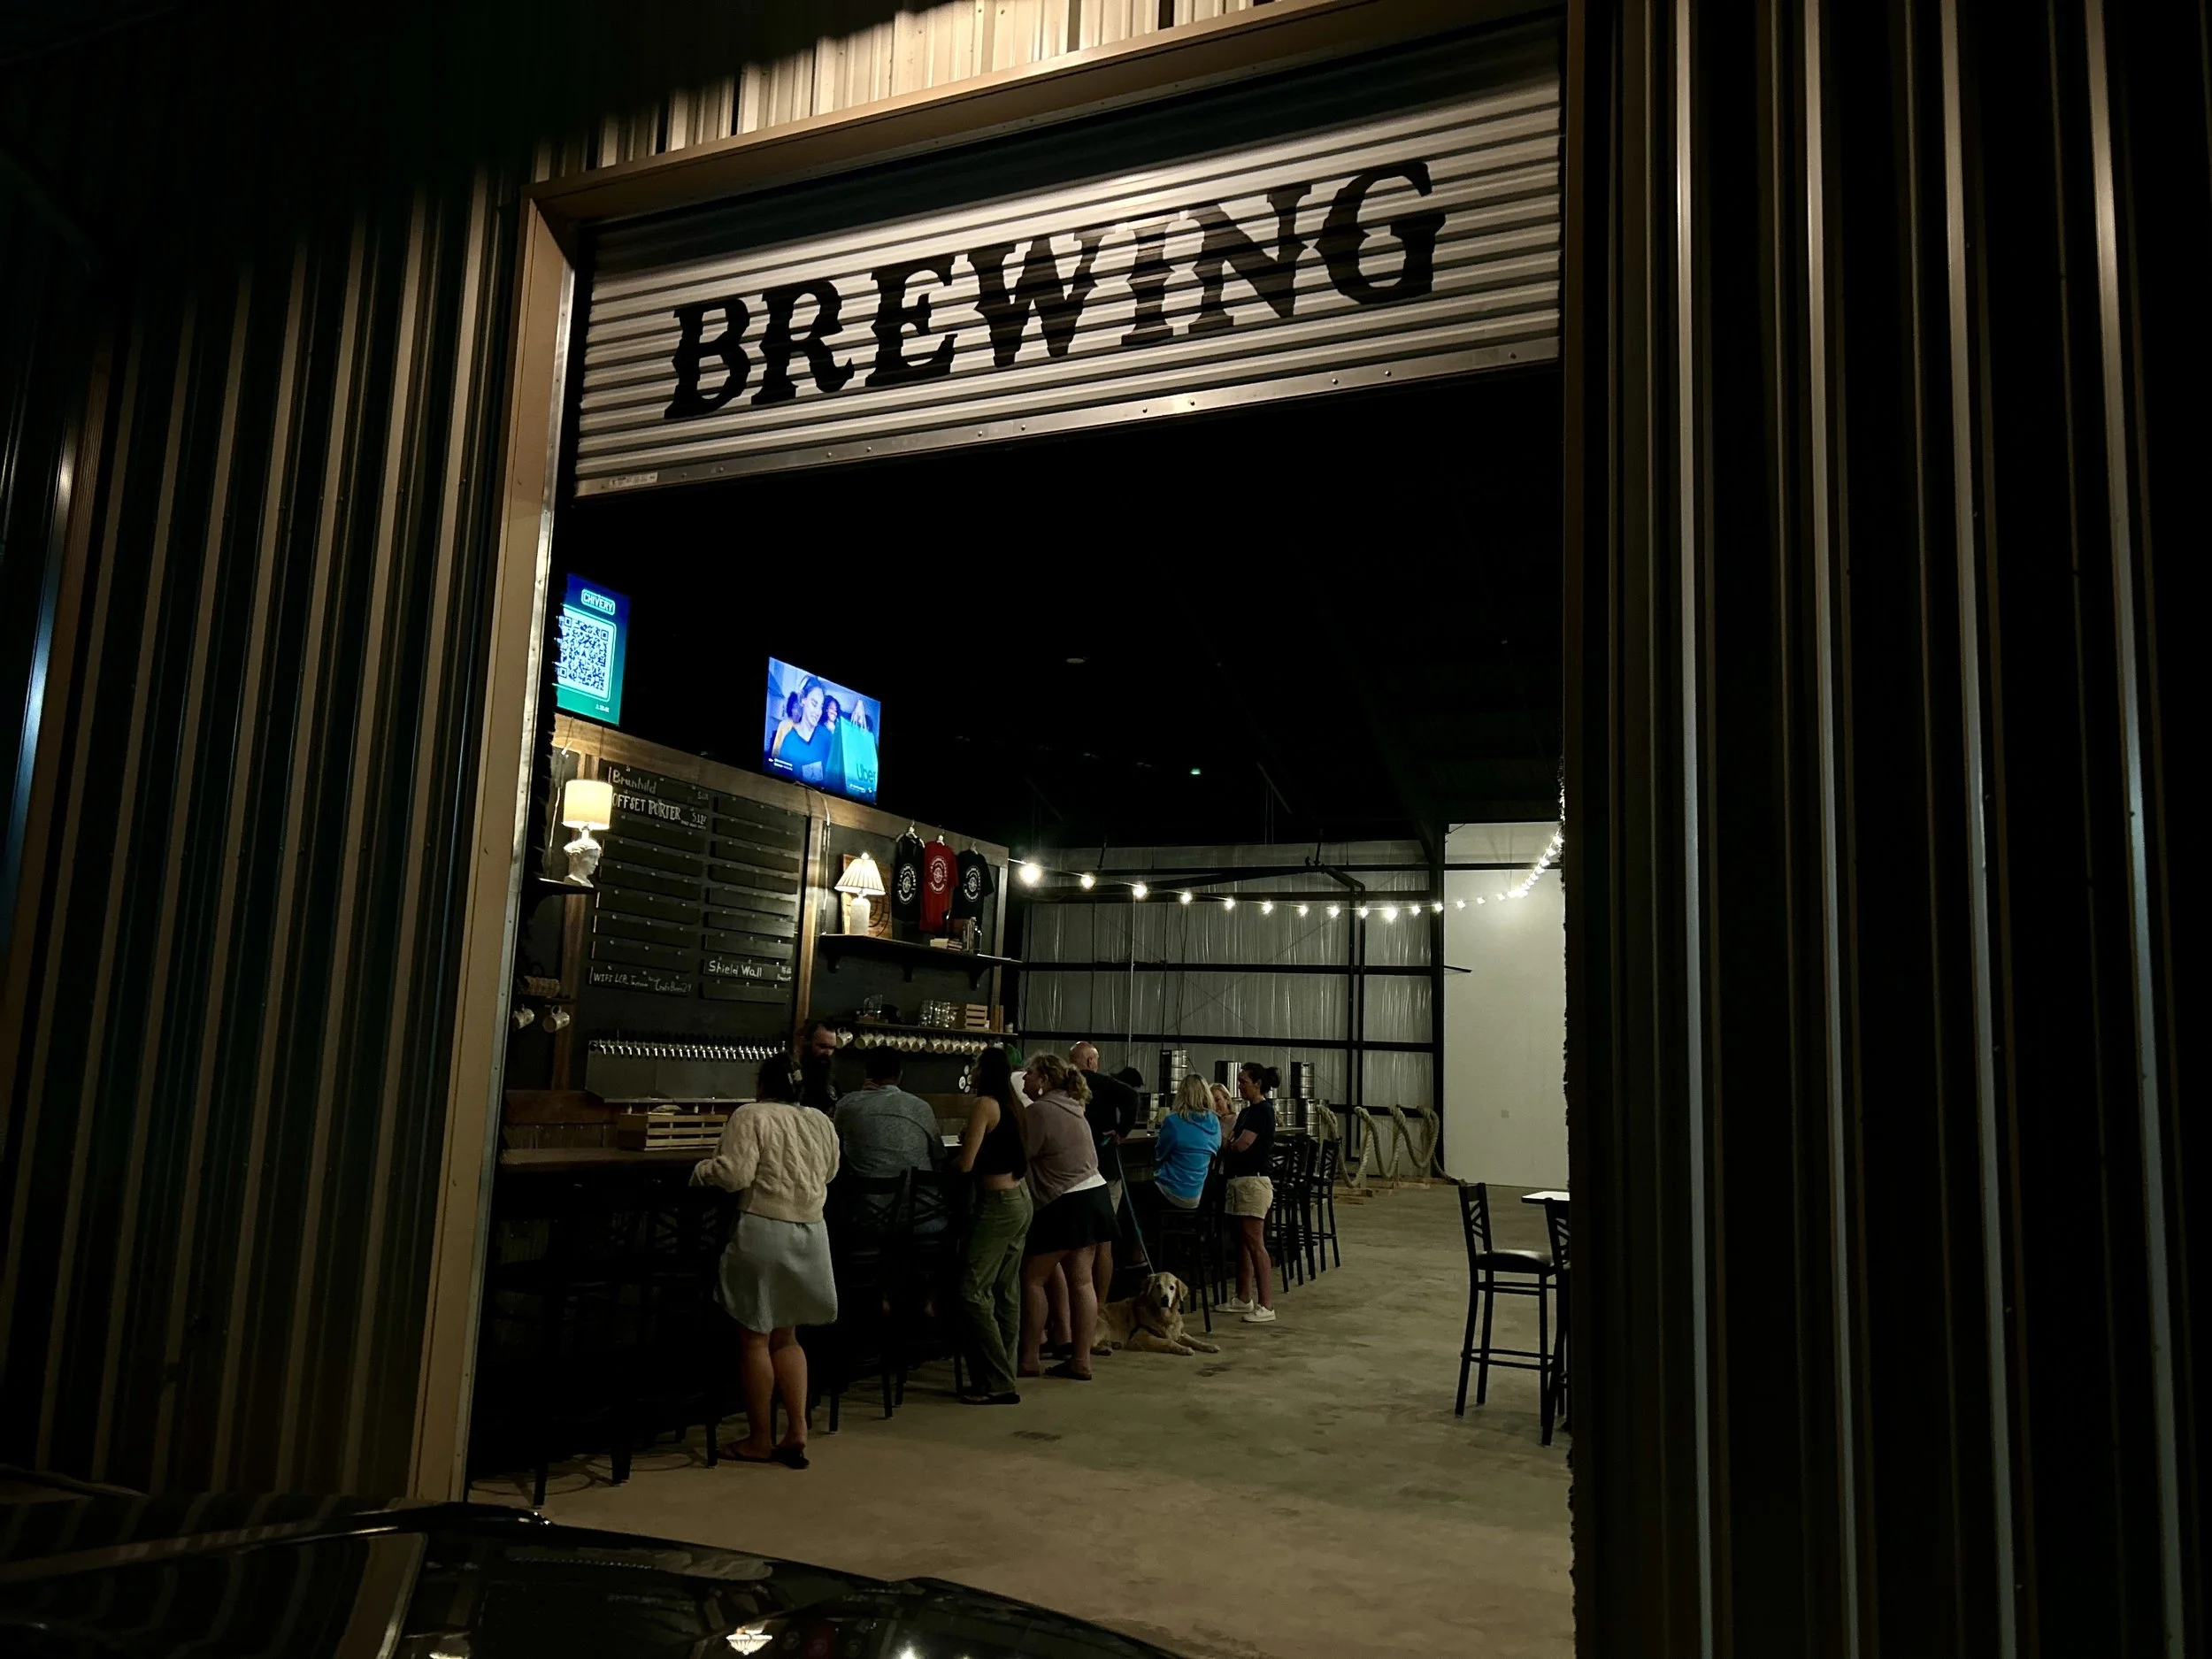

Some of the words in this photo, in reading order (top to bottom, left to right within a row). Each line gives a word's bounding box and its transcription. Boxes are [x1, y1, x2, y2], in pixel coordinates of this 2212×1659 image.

[664, 161, 1446, 420] BREWING
[612, 793, 647, 813] OFFSET
[648, 799, 681, 821] PORTER
[708, 960, 740, 977] Shield
[741, 964, 763, 978] Wall
